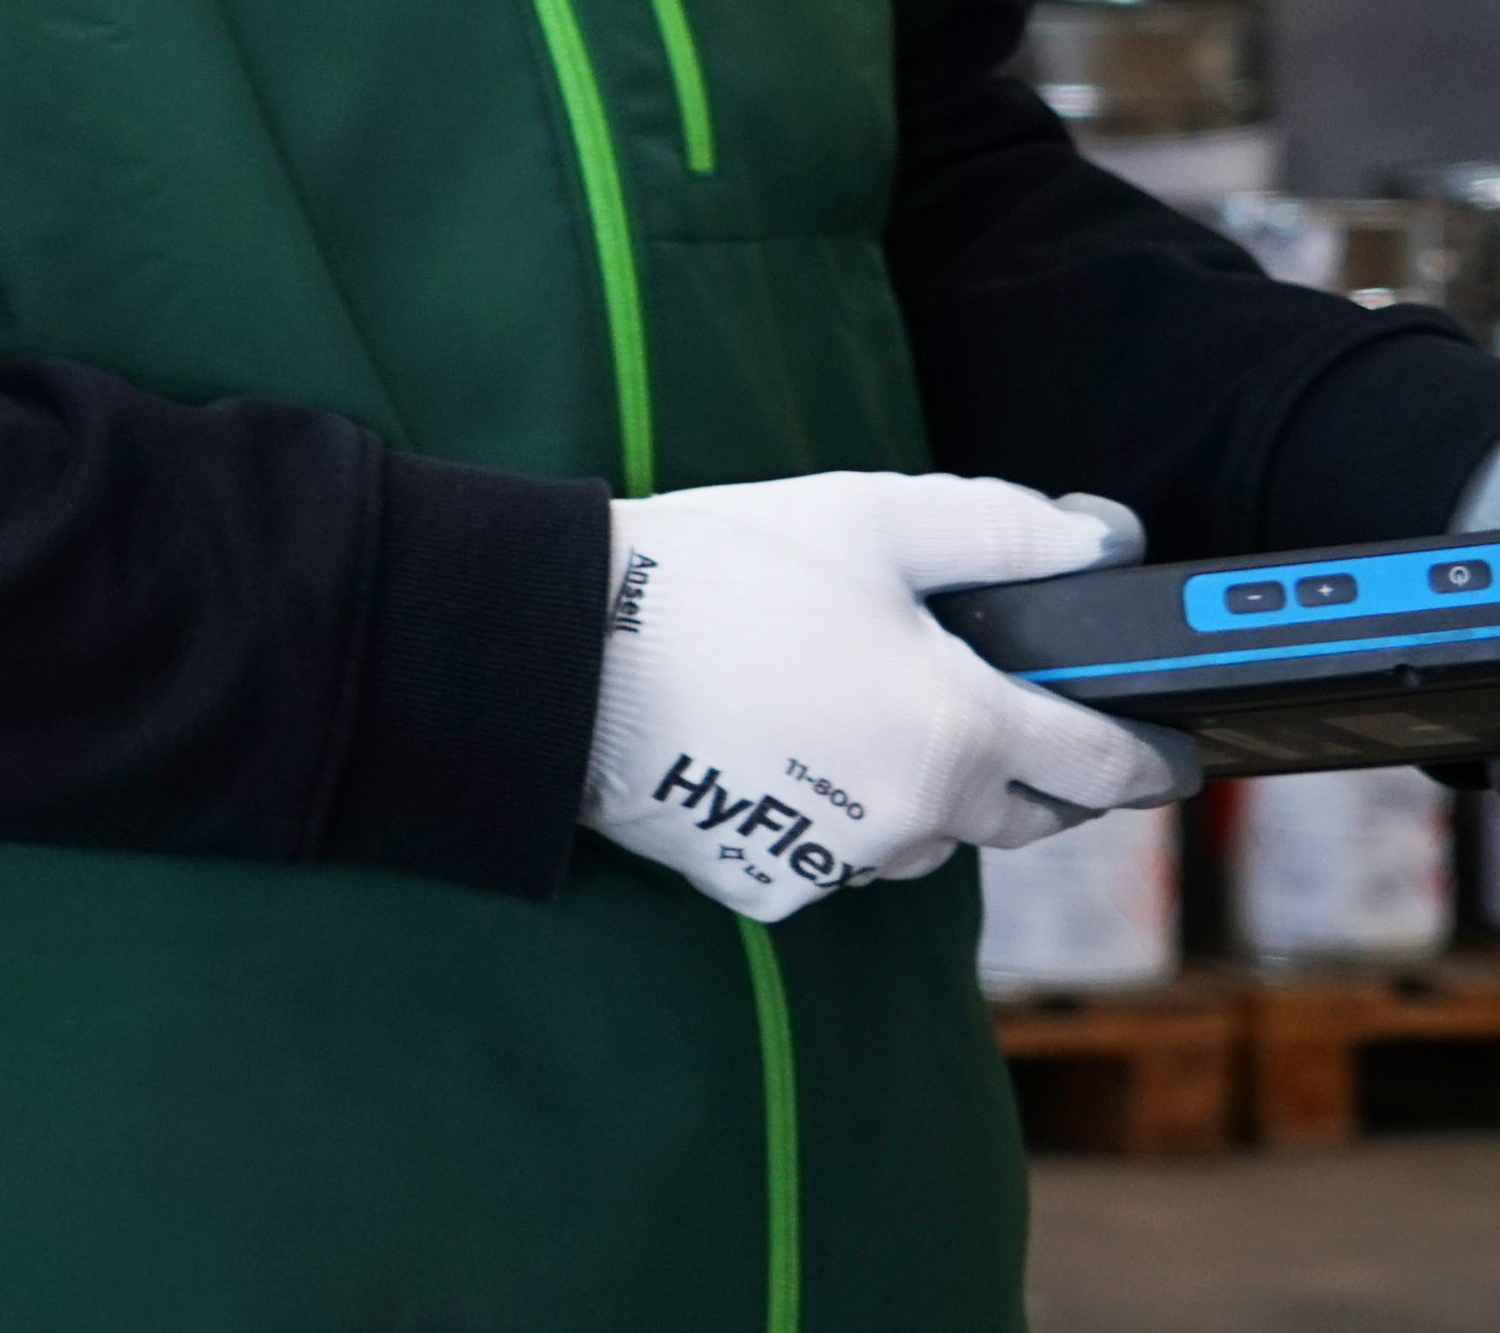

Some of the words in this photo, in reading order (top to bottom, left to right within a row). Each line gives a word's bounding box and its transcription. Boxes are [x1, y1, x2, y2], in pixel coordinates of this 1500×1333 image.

[614, 551, 659, 634] Ansell
[652, 754, 876, 889] HyFlex
[784, 759, 867, 821] 11-800
